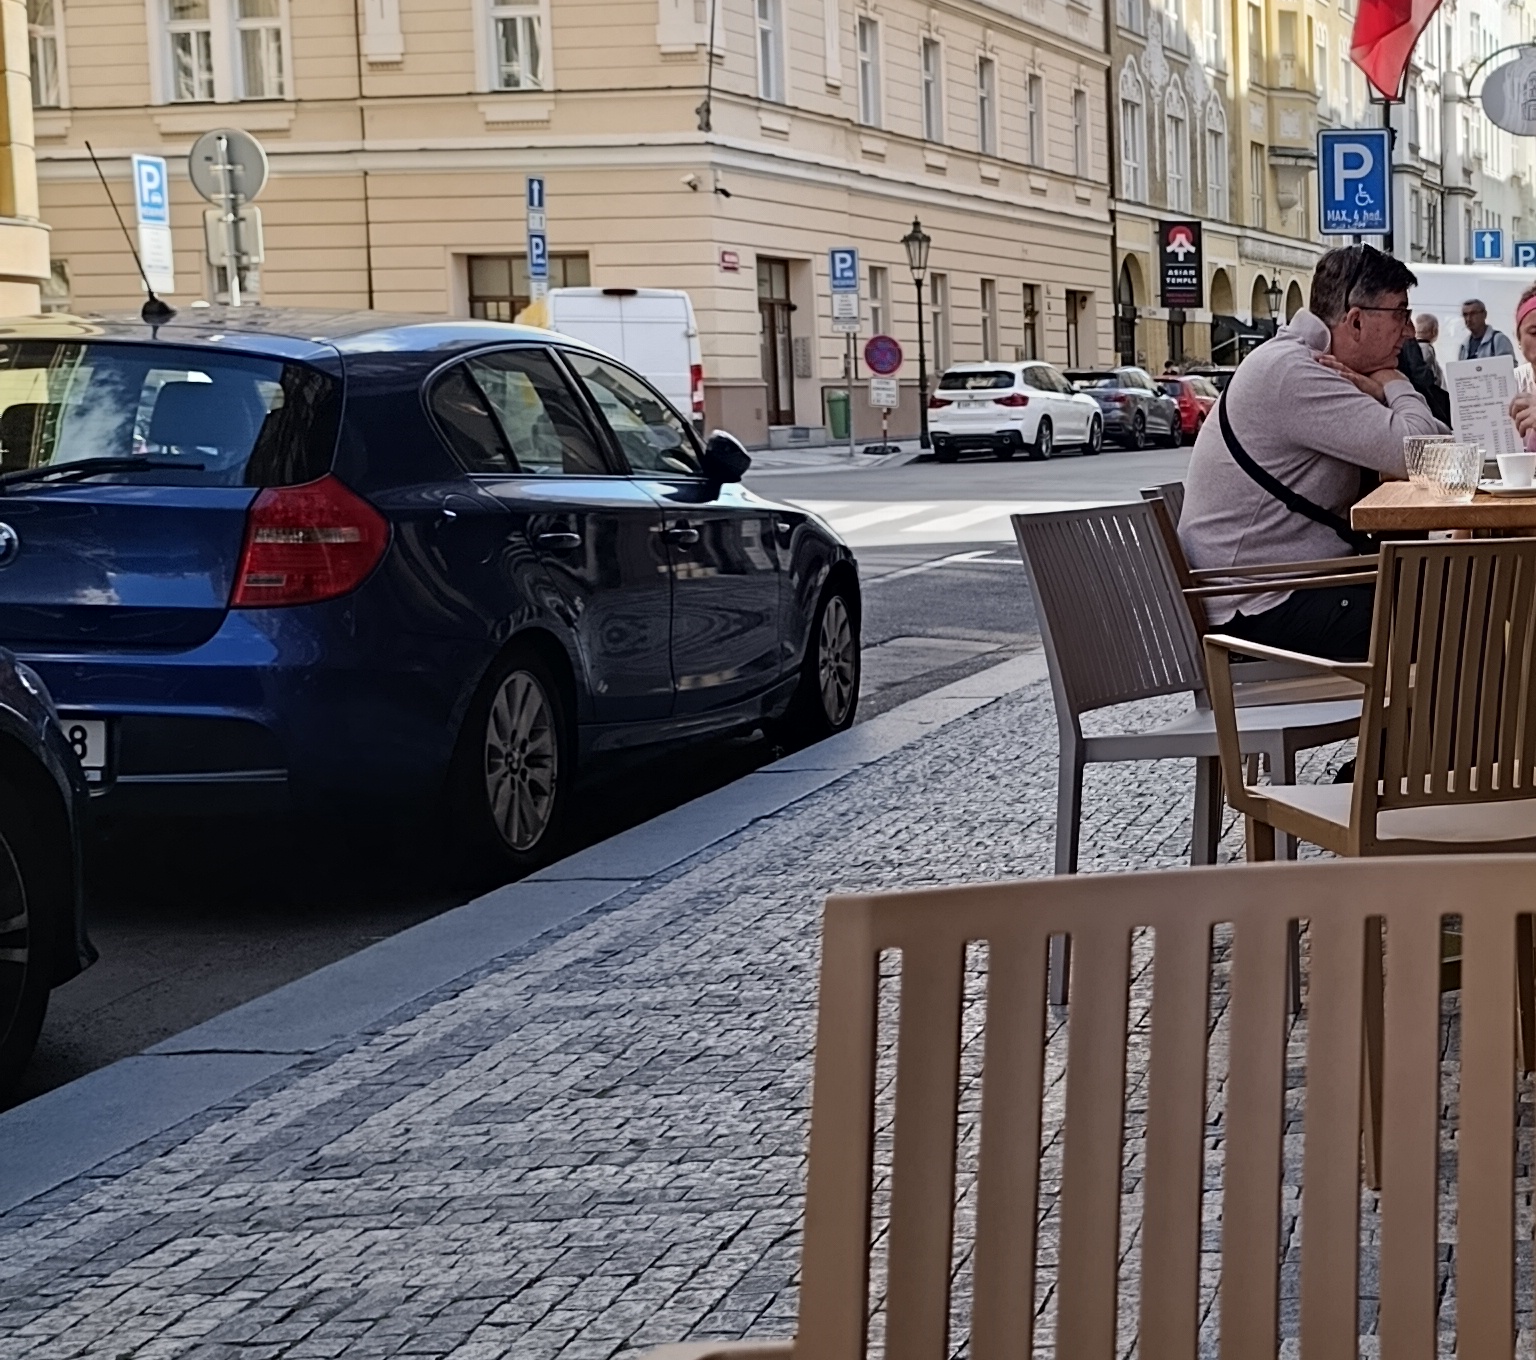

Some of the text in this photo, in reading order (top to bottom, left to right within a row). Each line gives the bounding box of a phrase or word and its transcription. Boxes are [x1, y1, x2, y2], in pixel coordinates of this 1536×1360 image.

[139, 163, 161, 203] P
[1333, 143, 1374, 201] P
[531, 237, 544, 264] P
[1518, 246, 1536, 268] P
[834, 252, 852, 278] P
